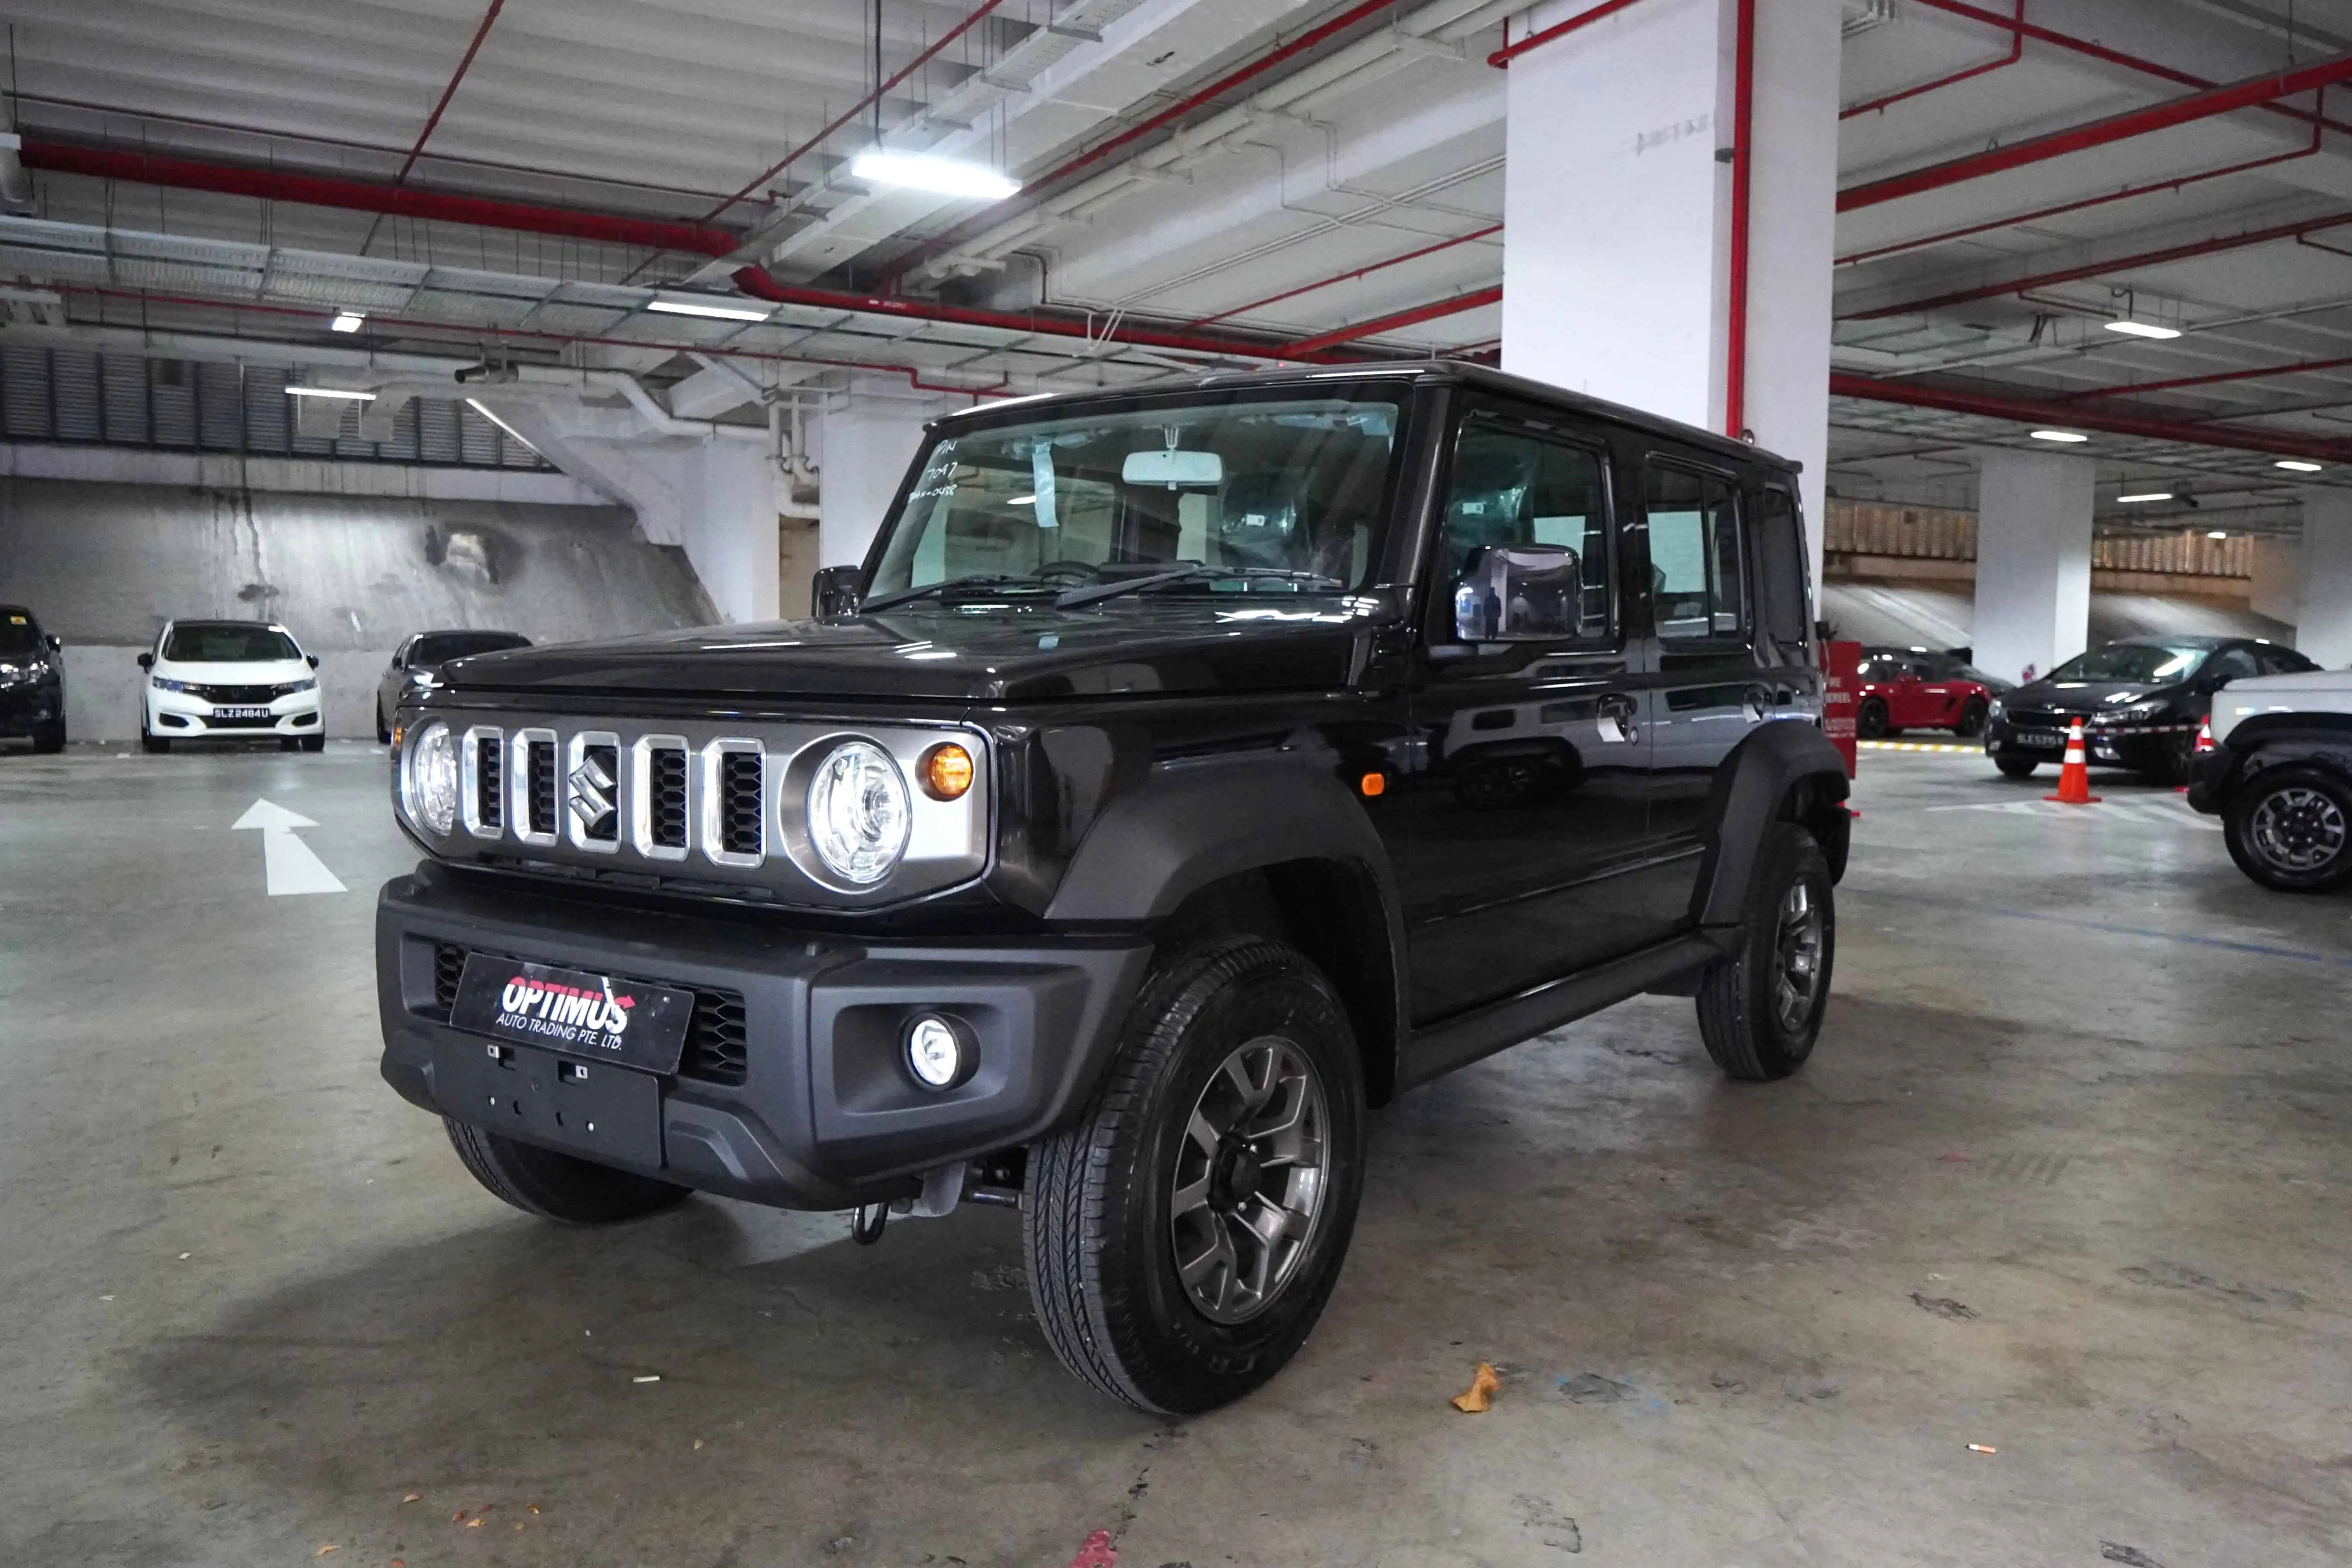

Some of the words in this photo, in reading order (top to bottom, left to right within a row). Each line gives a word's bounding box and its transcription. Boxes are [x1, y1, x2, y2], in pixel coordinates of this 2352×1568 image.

[502, 976, 635, 1034] OPTIMUS
[496, 1013, 527, 1029] AUTO
[528, 1018, 576, 1040] TRADING
[577, 1029, 598, 1045] PTE.
[601, 1034, 622, 1051] LTD.
